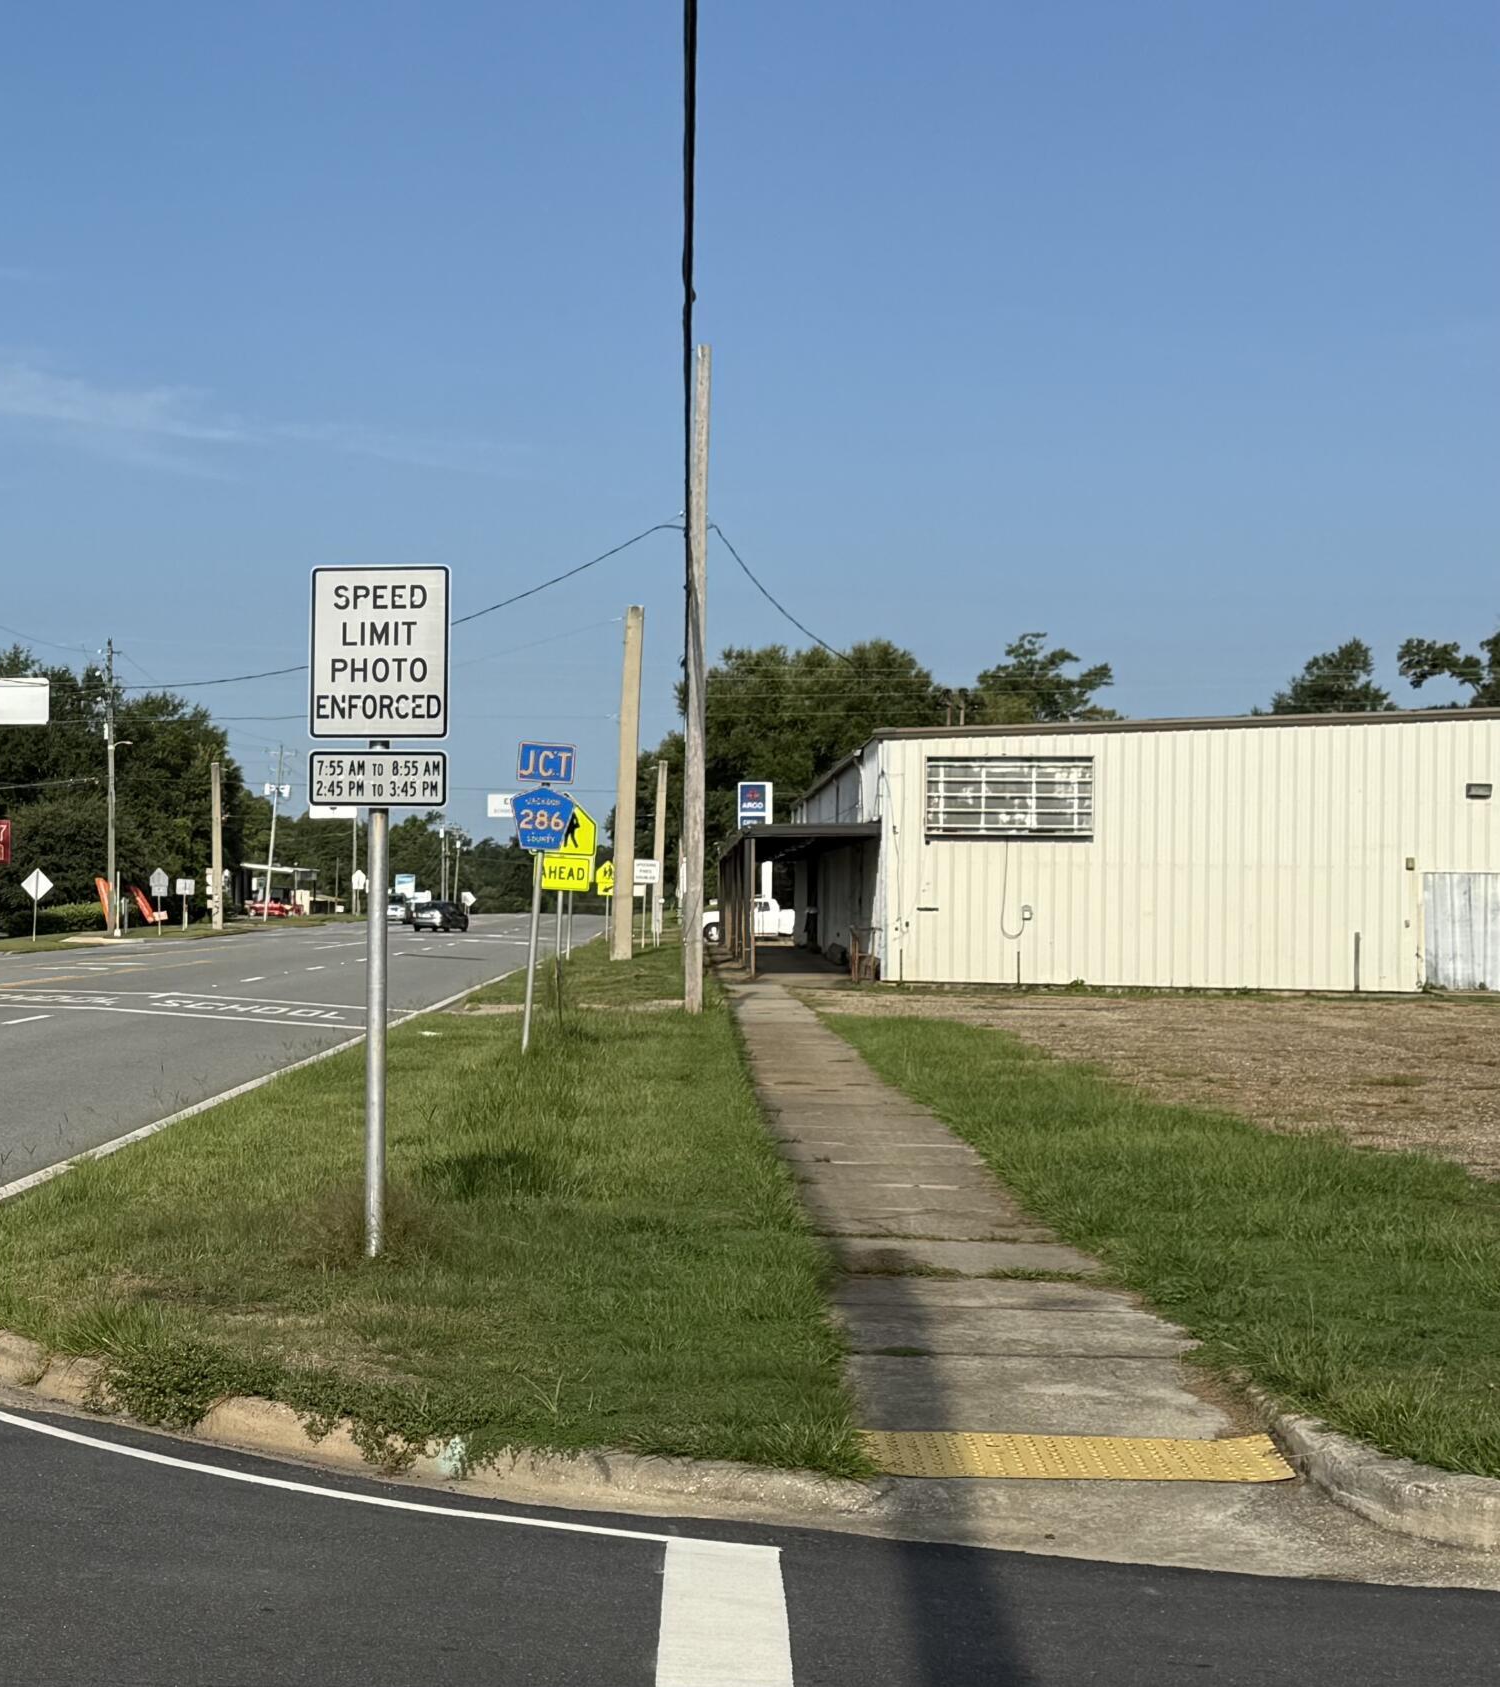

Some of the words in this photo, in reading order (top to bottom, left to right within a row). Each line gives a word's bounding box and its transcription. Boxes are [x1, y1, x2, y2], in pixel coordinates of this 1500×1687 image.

[333, 584, 428, 610] SPEED
[341, 621, 418, 646] LIMIT
[330, 657, 428, 683] PHOTO
[315, 694, 442, 720] ENFORCED
[316, 760, 344, 776] 7:55
[348, 760, 366, 776] AM
[372, 763, 384, 776] TO
[391, 760, 419, 776] 8:55
[423, 760, 441, 777] AM
[519, 750, 572, 778] JCT
[316, 780, 343, 797] 2:45
[348, 780, 364, 797] PM
[371, 782, 384, 797] TO
[389, 780, 417, 797] 3:45
[422, 780, 439, 797] PM
[520, 808, 564, 831] 286
[149, 999, 346, 1020] SCHOOL
